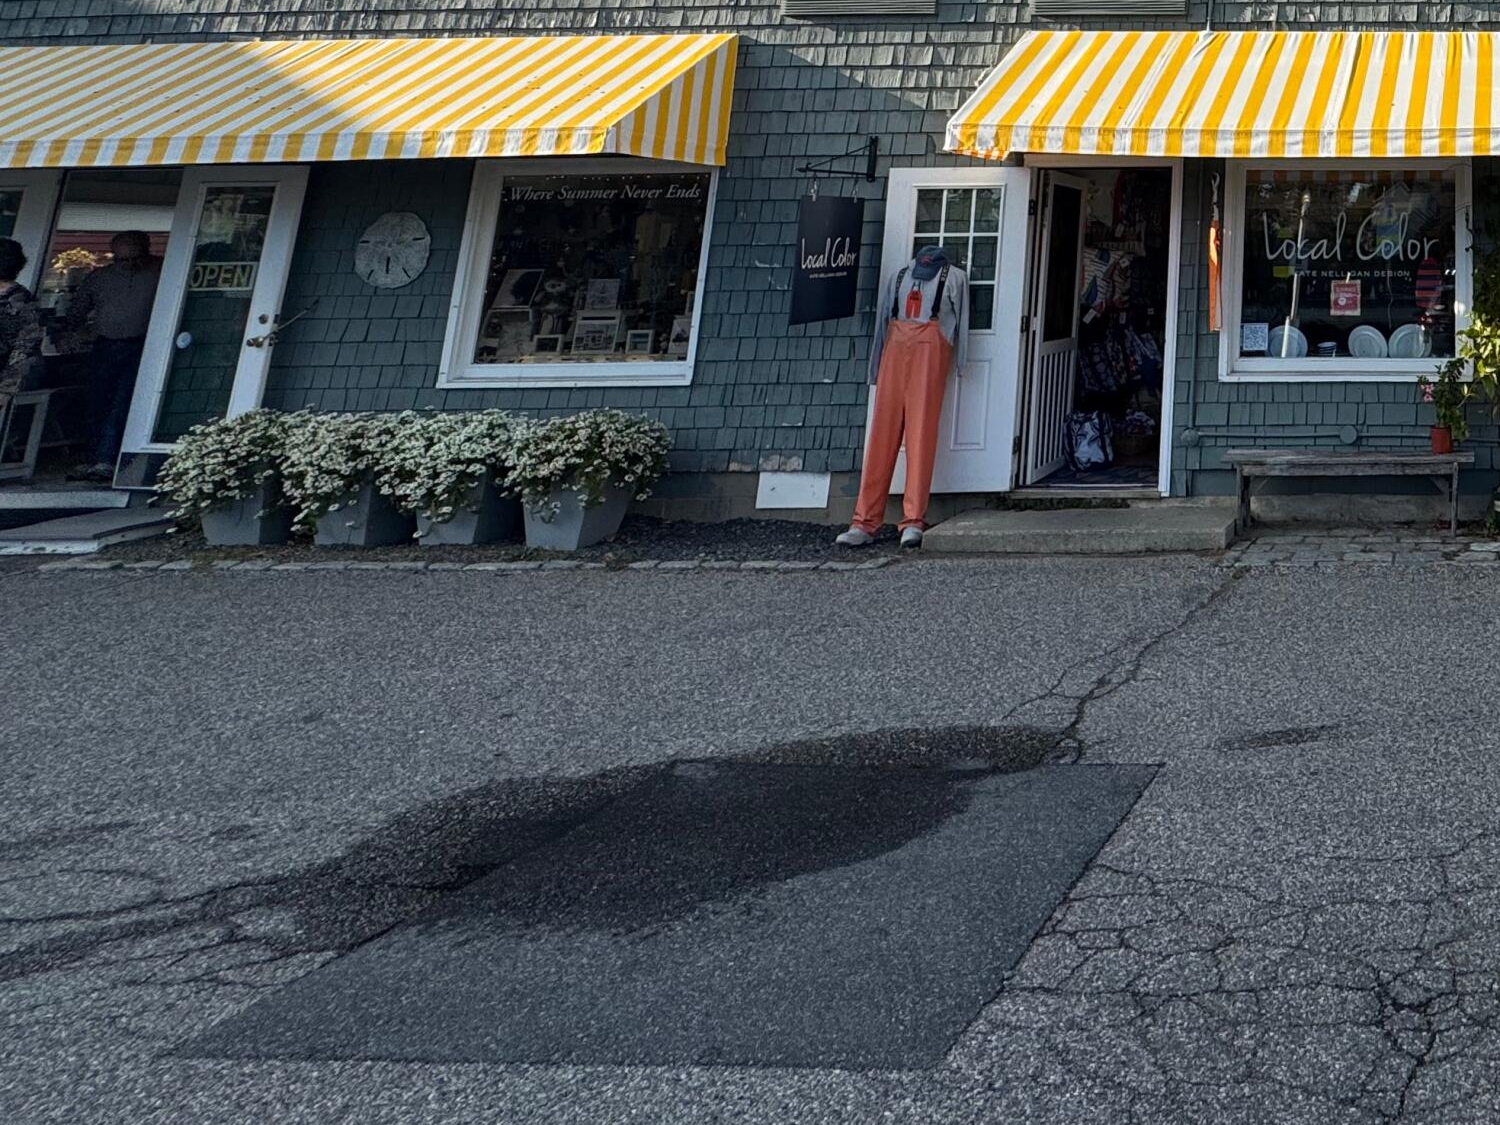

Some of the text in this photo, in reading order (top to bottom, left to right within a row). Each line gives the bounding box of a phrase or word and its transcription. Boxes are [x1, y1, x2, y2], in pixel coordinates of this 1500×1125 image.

[511, 183, 701, 202] Where Summer Never Ends
[1262, 211, 1440, 261] Local Color
[801, 236, 857, 269] Local Color
[191, 265, 251, 287] OPEN
